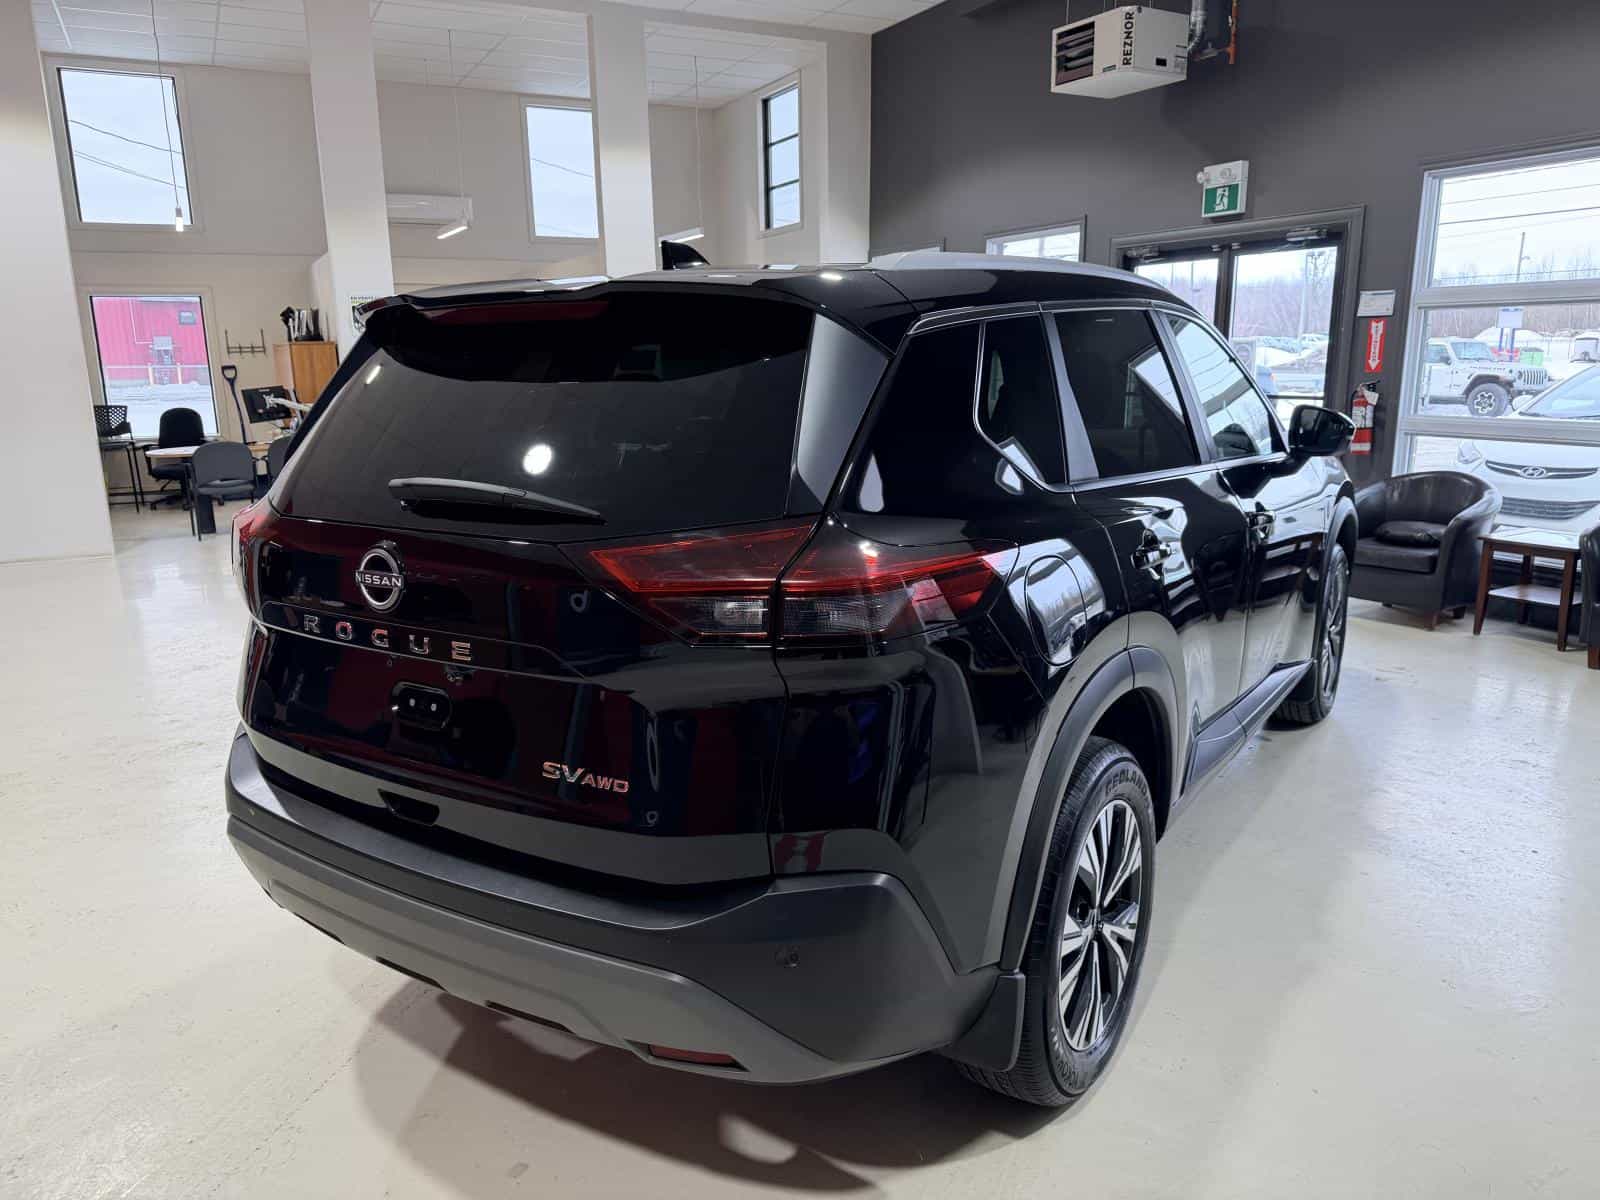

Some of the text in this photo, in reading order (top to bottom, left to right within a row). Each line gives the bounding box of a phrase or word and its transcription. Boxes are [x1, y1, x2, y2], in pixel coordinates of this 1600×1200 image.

[1122, 11, 1135, 66] REZNOR
[356, 571, 401, 587] NISSAN
[303, 614, 472, 661] ROGUE
